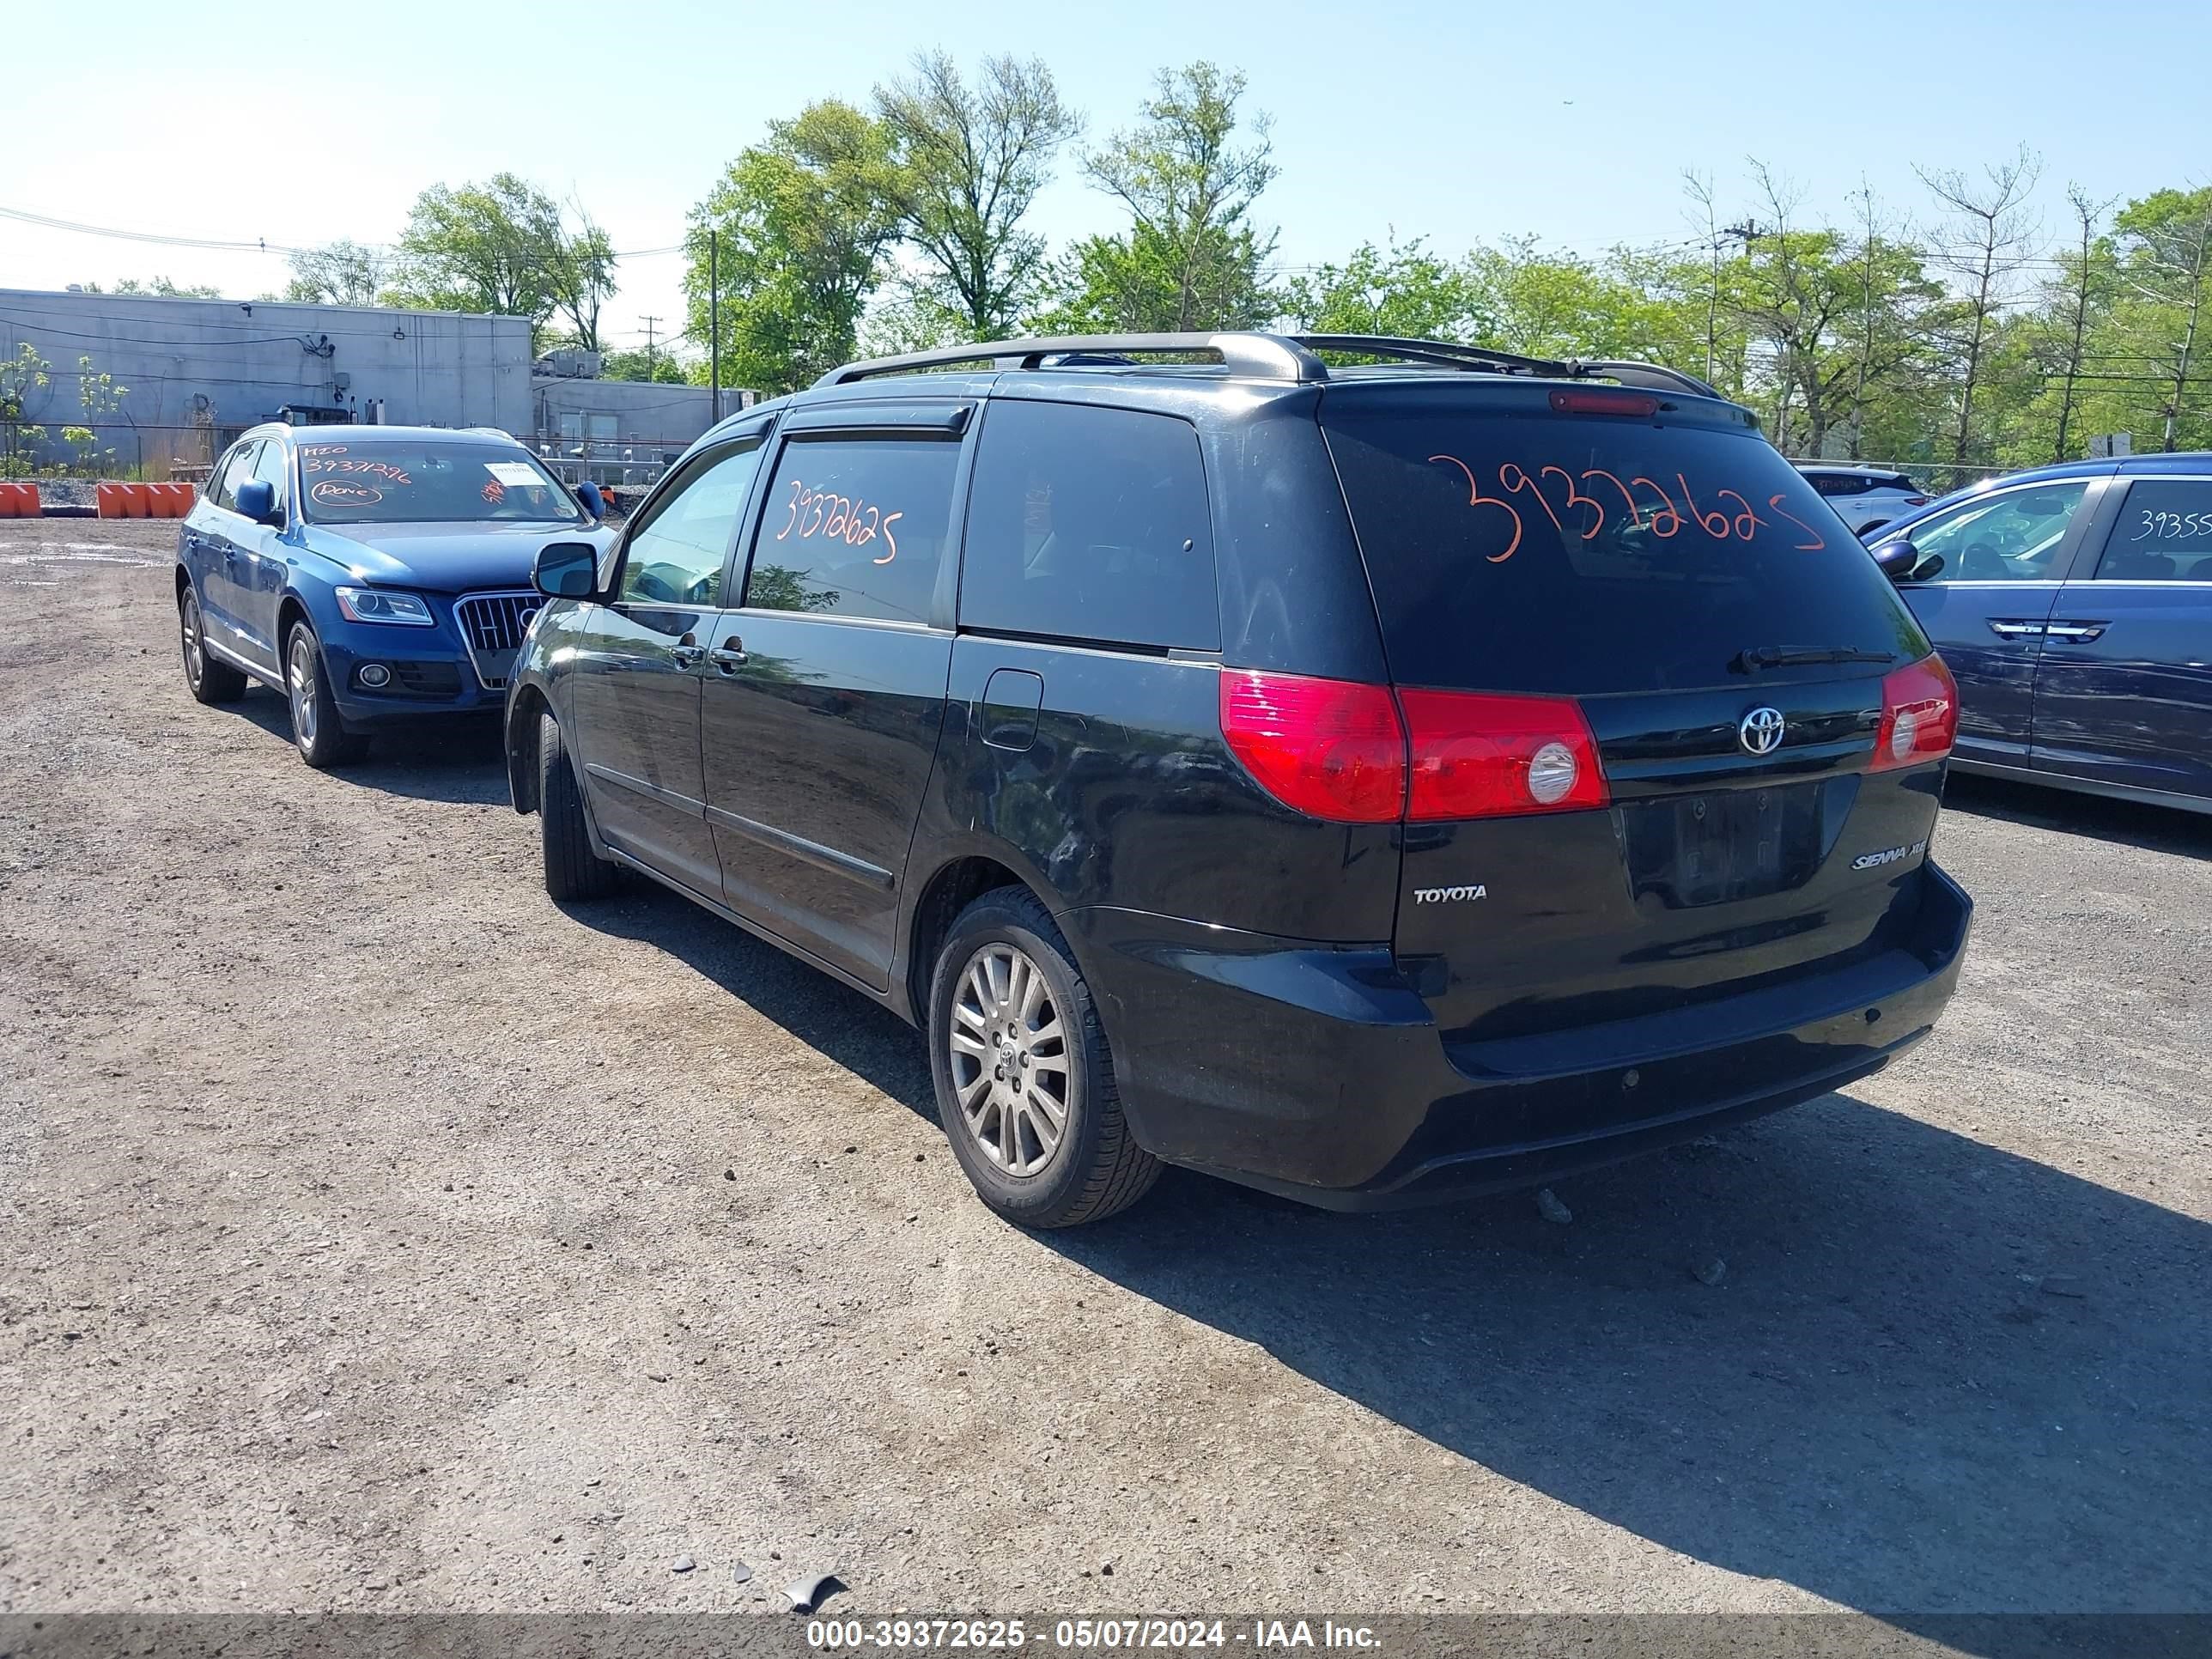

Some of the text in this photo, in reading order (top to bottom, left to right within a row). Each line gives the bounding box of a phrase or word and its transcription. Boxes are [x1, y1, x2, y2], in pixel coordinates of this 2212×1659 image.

[305, 459, 412, 484] 39371296
[1428, 455, 1826, 562] 39372625
[776, 480, 902, 564] 39372625
[1850, 846, 1906, 870] SIENNA
[1413, 884, 1487, 905] TOYOTA
